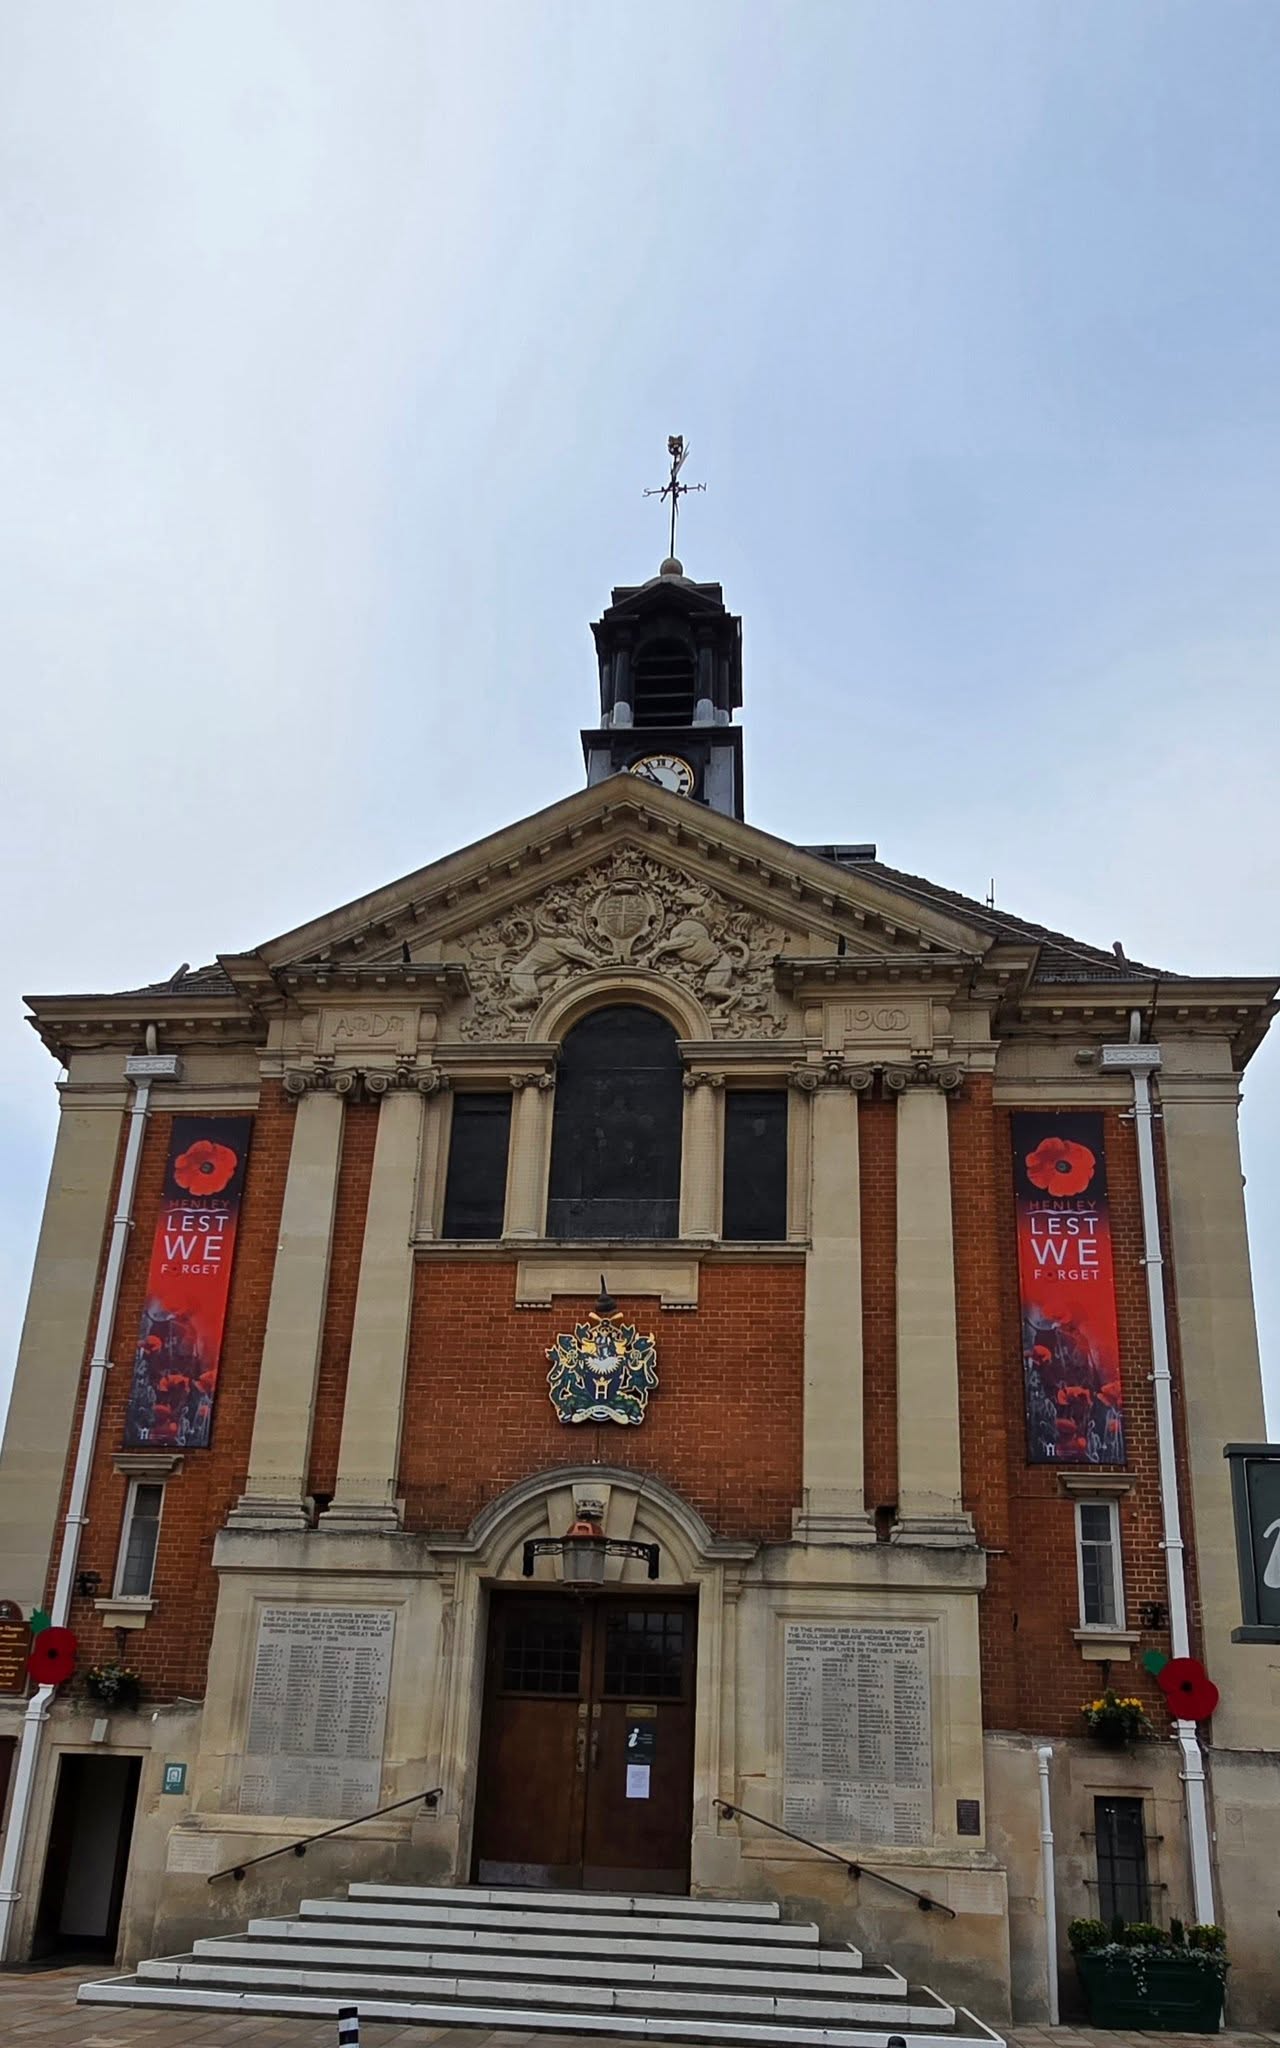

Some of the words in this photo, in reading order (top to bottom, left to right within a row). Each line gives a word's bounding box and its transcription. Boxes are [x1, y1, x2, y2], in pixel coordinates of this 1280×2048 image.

[844, 1008, 910, 1032] 1900
[169, 1200, 230, 1209] HENLEY
[1029, 1200, 1096, 1210] HENLEY
[166, 1215, 229, 1232] LEST
[1031, 1217, 1099, 1235] LEST
[164, 1235, 223, 1261] WE
[1030, 1239, 1099, 1265] WE
